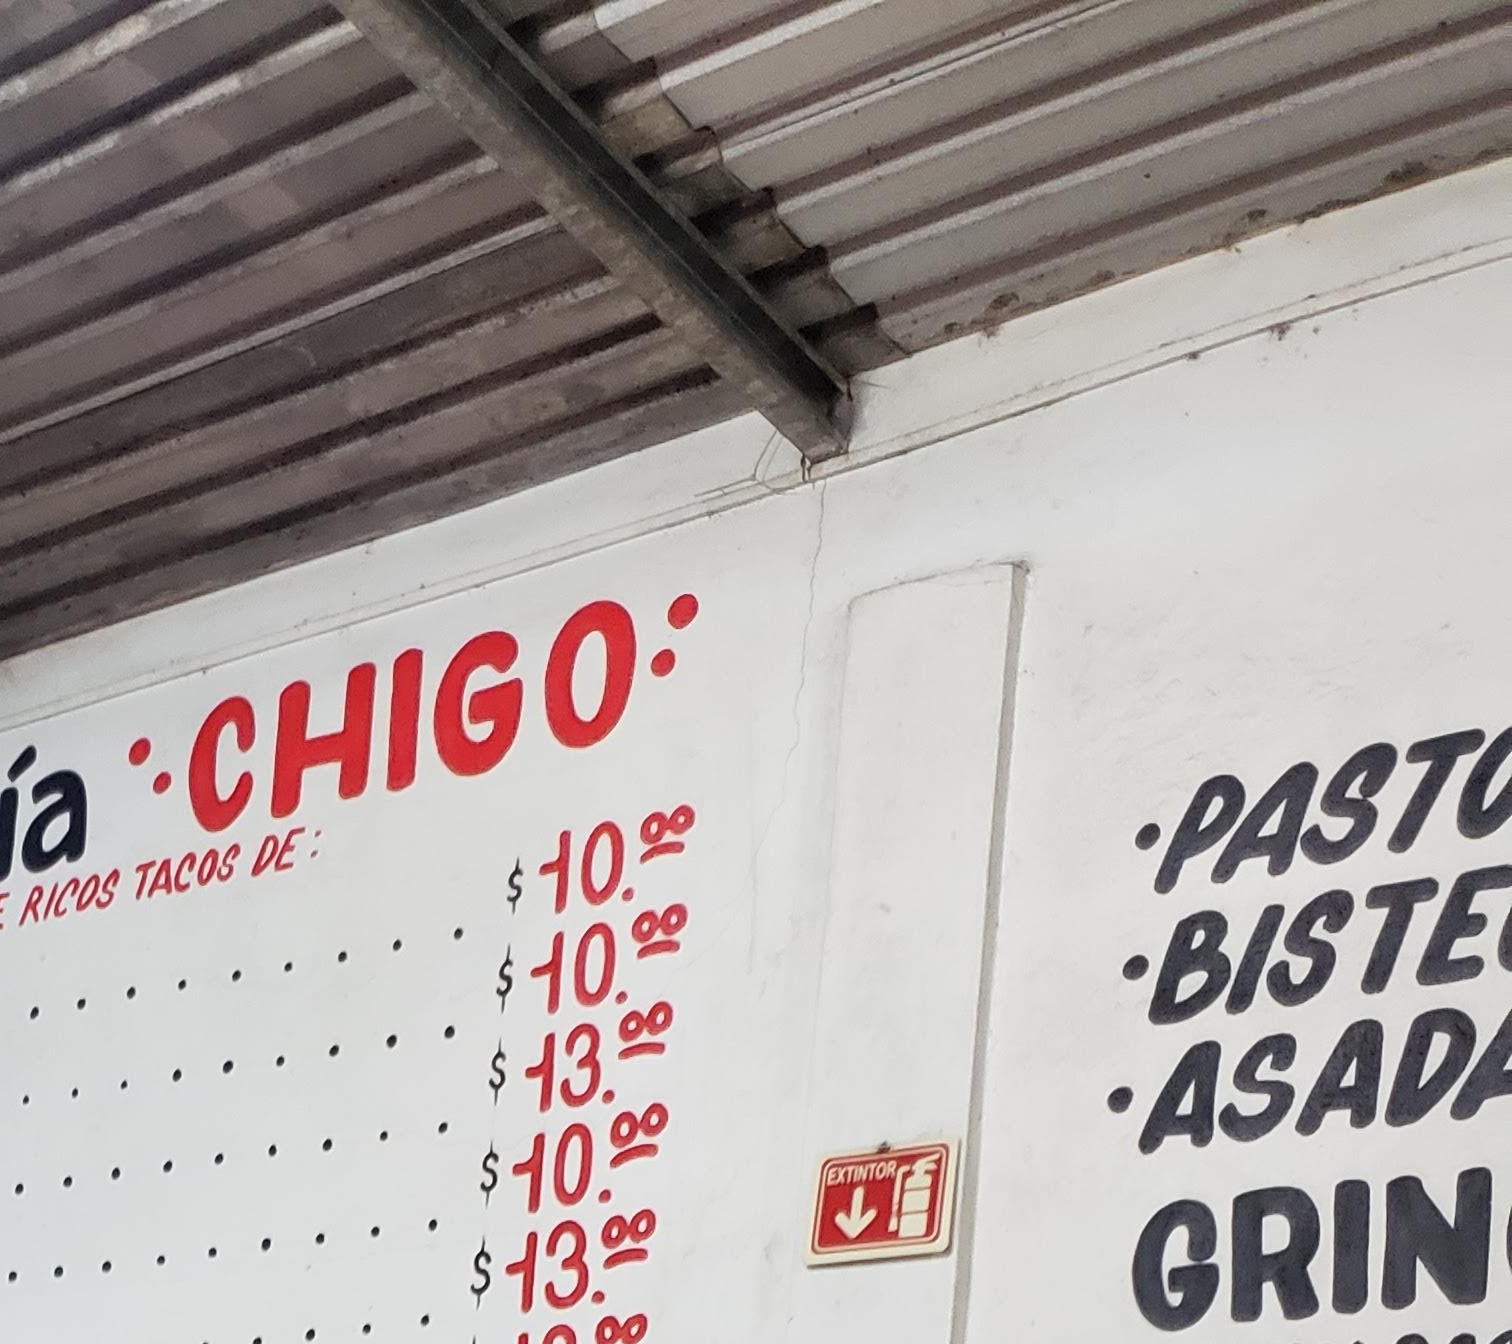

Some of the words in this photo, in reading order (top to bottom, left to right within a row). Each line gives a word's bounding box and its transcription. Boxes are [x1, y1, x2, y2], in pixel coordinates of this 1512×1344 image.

[20, 868, 121, 926] RICOS
[135, 842, 242, 900] TACOS
[1148, 864, 1512, 1025] BISTE
[826, 1160, 897, 1187] EXTINTOR
